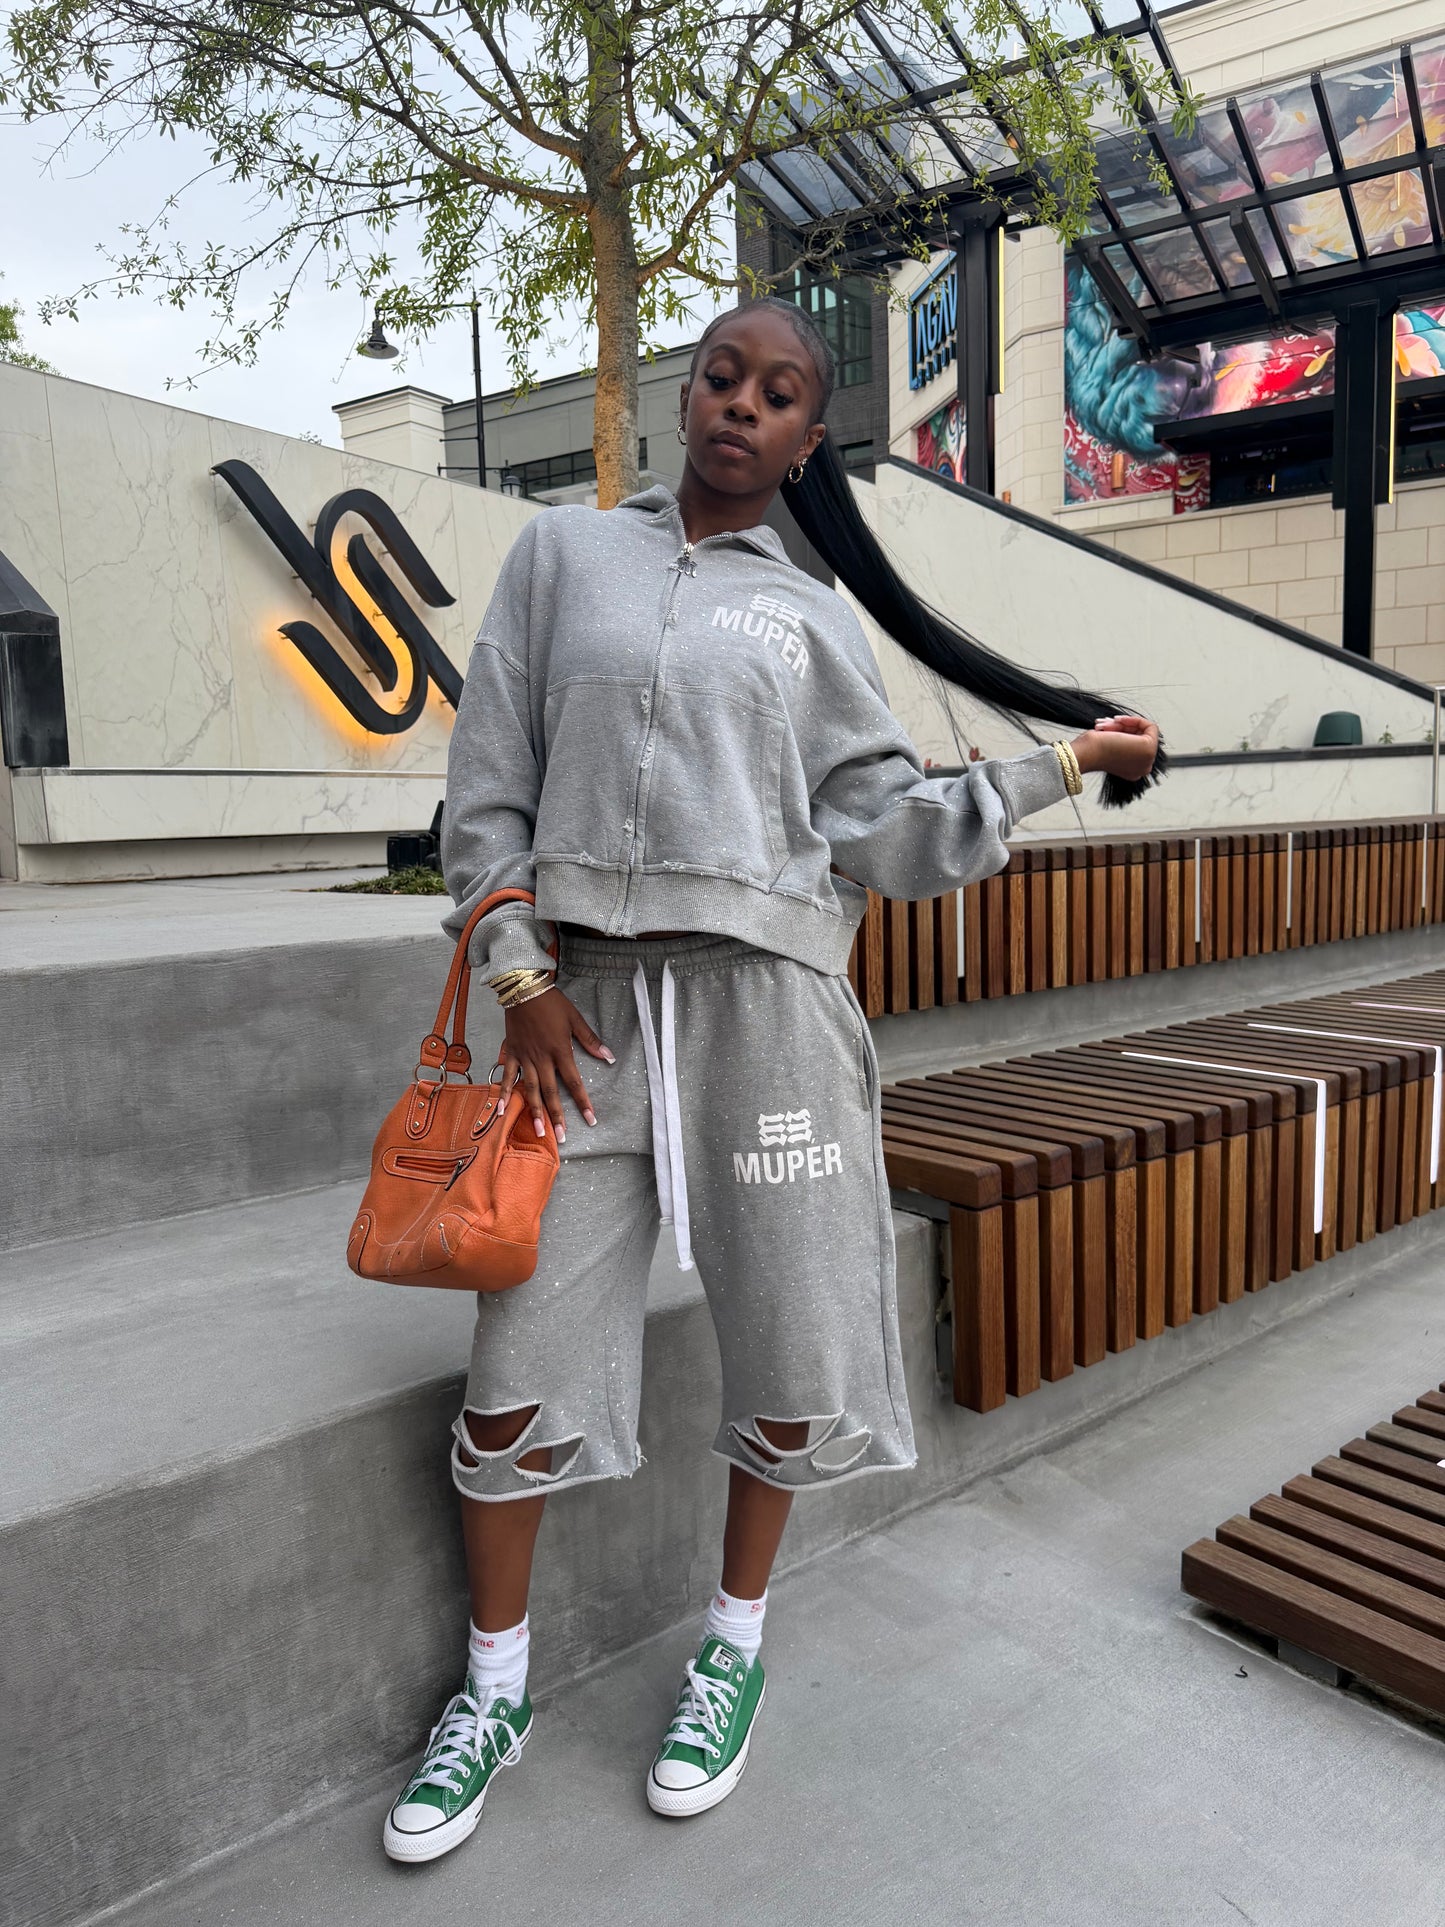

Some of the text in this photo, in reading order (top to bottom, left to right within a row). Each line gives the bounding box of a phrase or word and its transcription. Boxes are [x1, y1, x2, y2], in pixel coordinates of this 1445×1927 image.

[917, 272, 957, 363] AGAV
[711, 606, 809, 679] MUPER
[733, 1143, 843, 1184] MUPER
